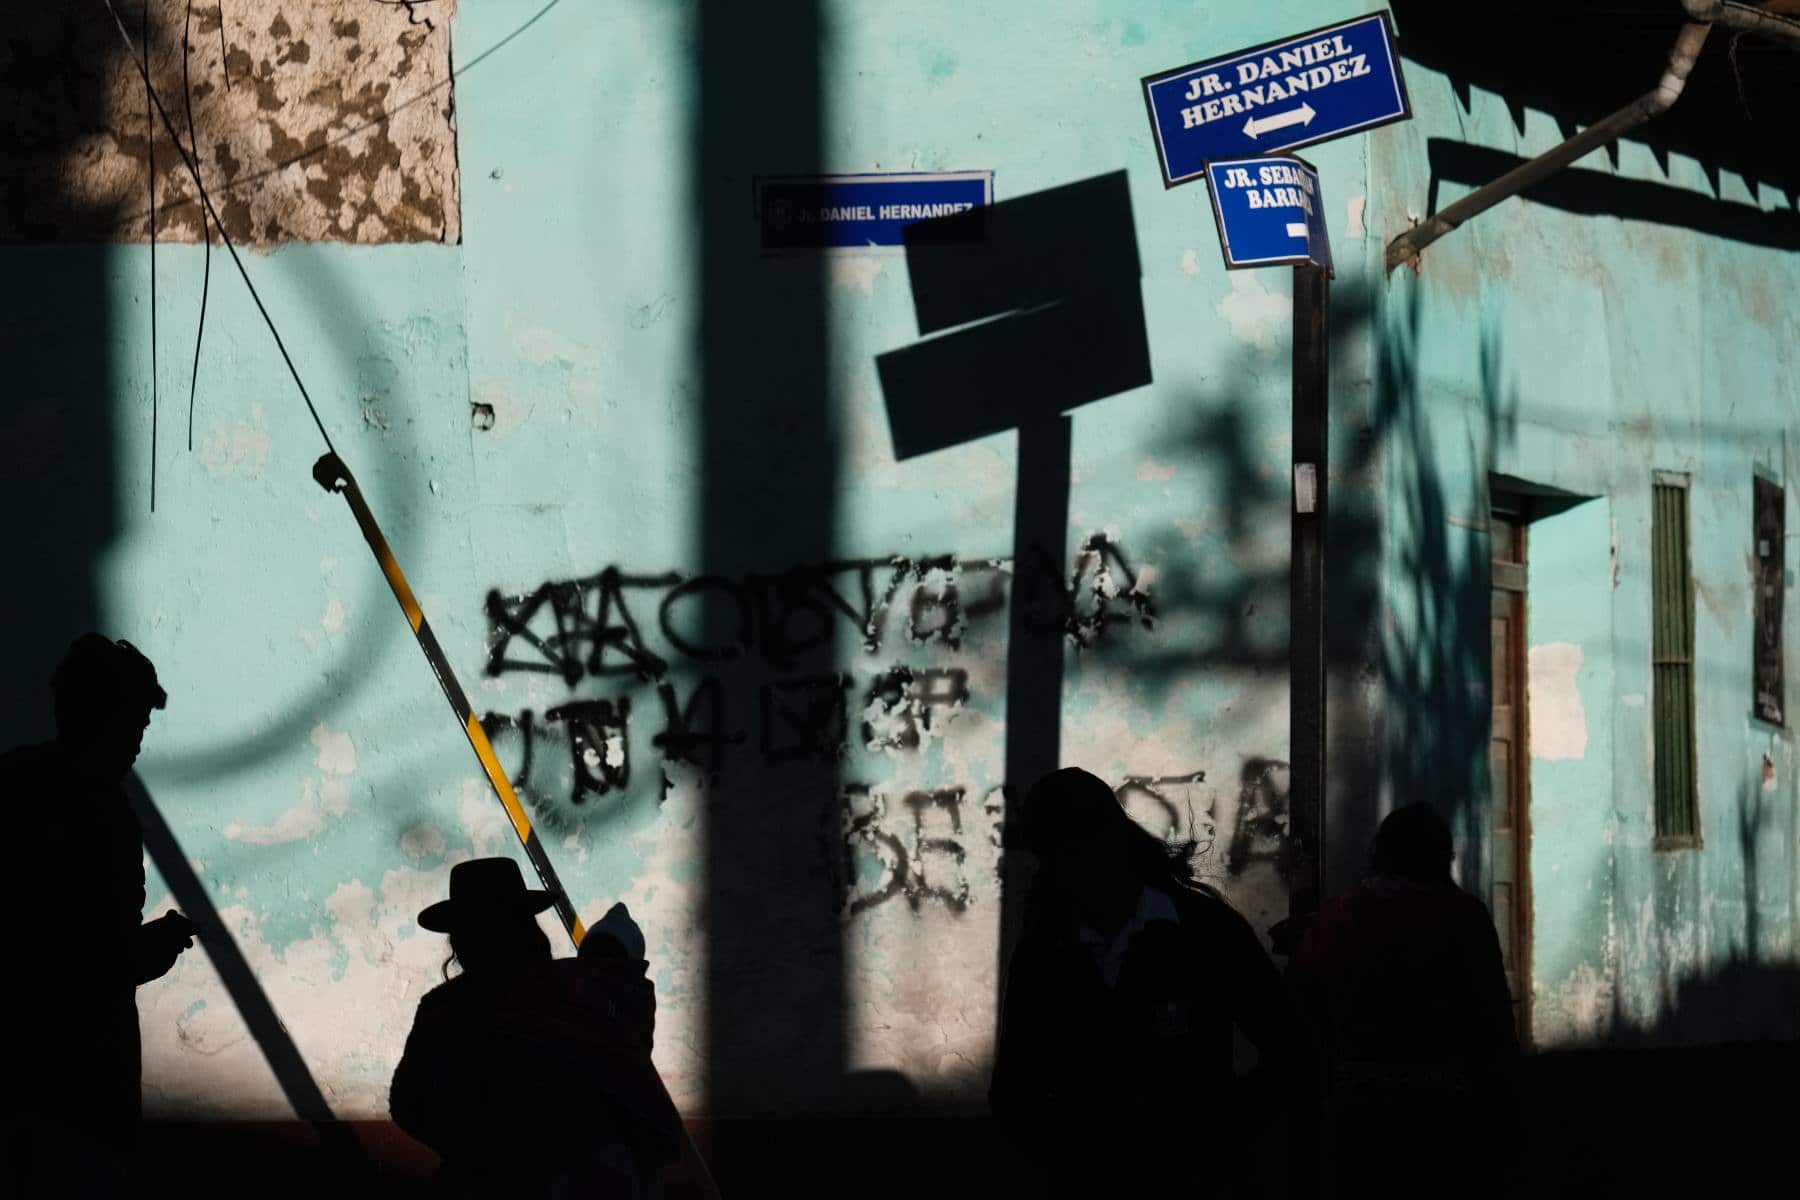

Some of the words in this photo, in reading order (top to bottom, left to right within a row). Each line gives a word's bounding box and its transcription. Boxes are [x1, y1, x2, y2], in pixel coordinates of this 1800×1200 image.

[1184, 72, 1233, 102] JR.
[1236, 34, 1353, 86] DANIEL
[1179, 53, 1372, 130] HERNANDEZ
[1223, 168, 1258, 189] JR.
[820, 205, 876, 222] DANIEL
[879, 202, 974, 220] HERNANDEZ
